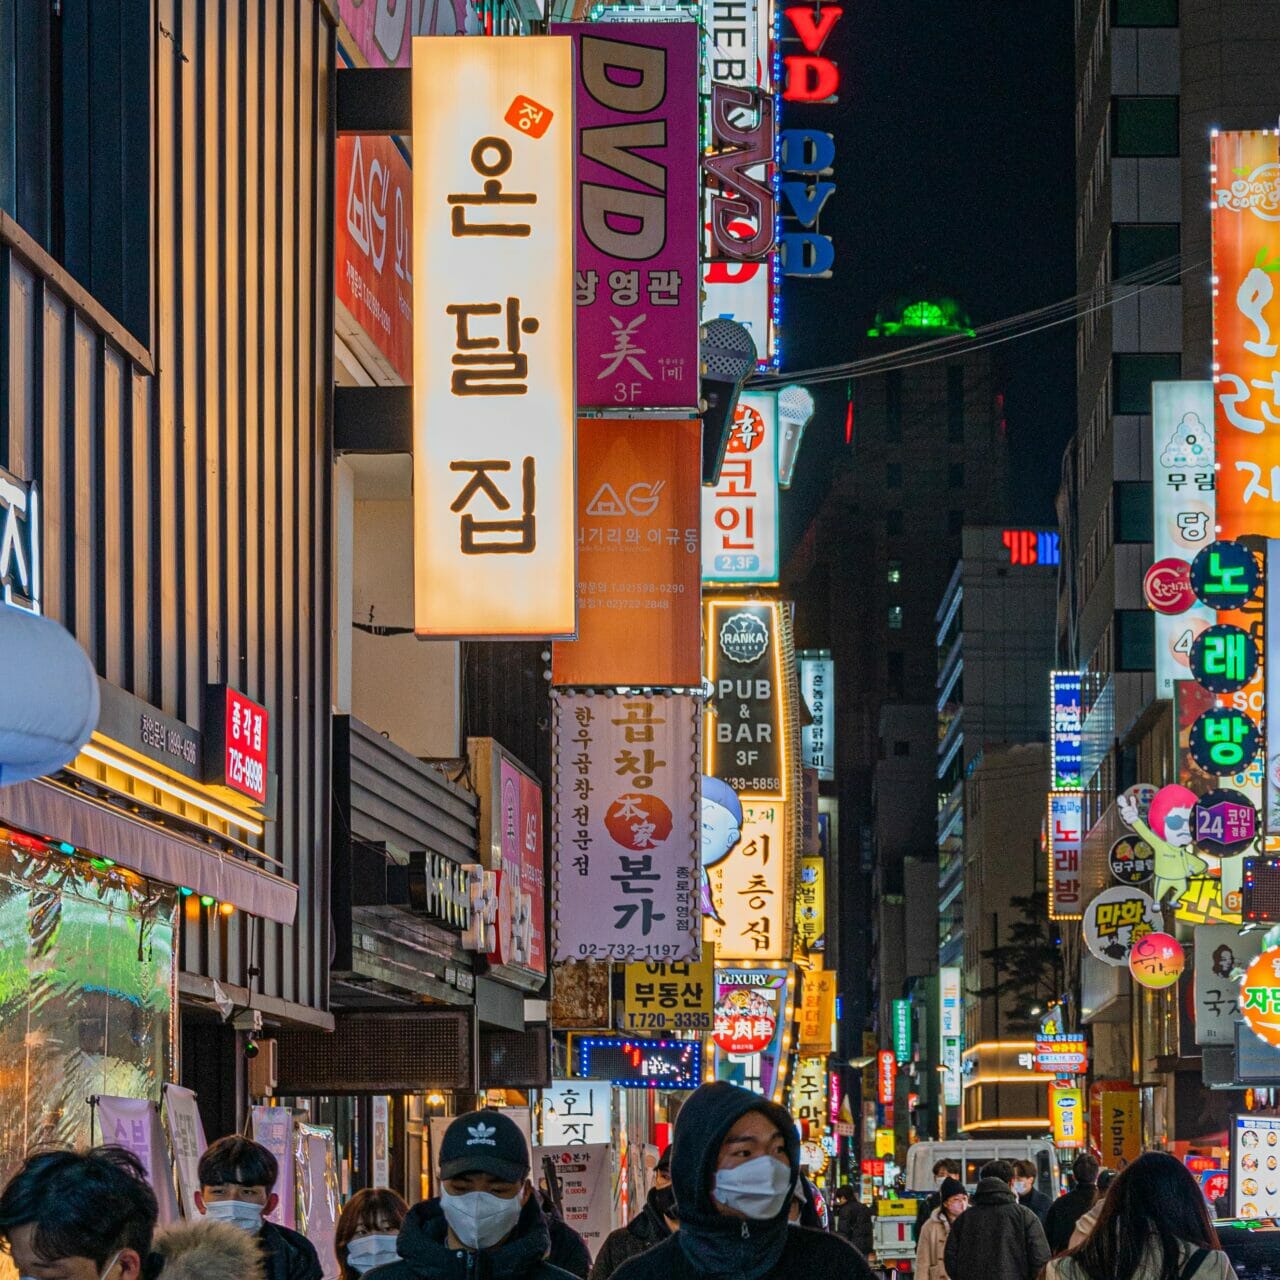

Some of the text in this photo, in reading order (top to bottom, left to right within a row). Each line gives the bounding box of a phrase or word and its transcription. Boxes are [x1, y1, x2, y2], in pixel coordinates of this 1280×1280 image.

[580, 34, 667, 261] DVD
[781, 129, 837, 277] DVD
[576, 270, 682, 307] 상영관
[446, 136, 540, 557] 온달집
[597, 314, 655, 380] 美
[614, 383, 642, 401] 3F
[712, 460, 758, 553] 코인
[647, 527, 697, 553] 이규동
[724, 633, 764, 644] RANKA
[1204, 553, 1250, 765] 노래방
[718, 679, 771, 700] PUB
[739, 704, 750, 718] &
[167, 730, 196, 765] 1899-4586
[611, 700, 666, 789] 곱창
[717, 723, 772, 743] BAR
[228, 747, 263, 794] 725-9998
[736, 750, 758, 766] 3F
[571, 706, 592, 876] 한우곱창전문점
[1200, 811, 1223, 838] 24
[1227, 809, 1250, 827] 코인
[1054, 820, 1079, 903] 노래방
[610, 852, 667, 937] 본가
[737, 834, 775, 953] 이층집
[1096, 900, 1146, 936] 만화
[579, 944, 681, 956] 02-732-1197
[635, 983, 703, 1008] 부동산
[719, 974, 768, 986] LUXURY
[629, 1013, 710, 1028] T.720-3335
[714, 1020, 773, 1041] 羊肉串
[1110, 1108, 1124, 1157] Alpha
